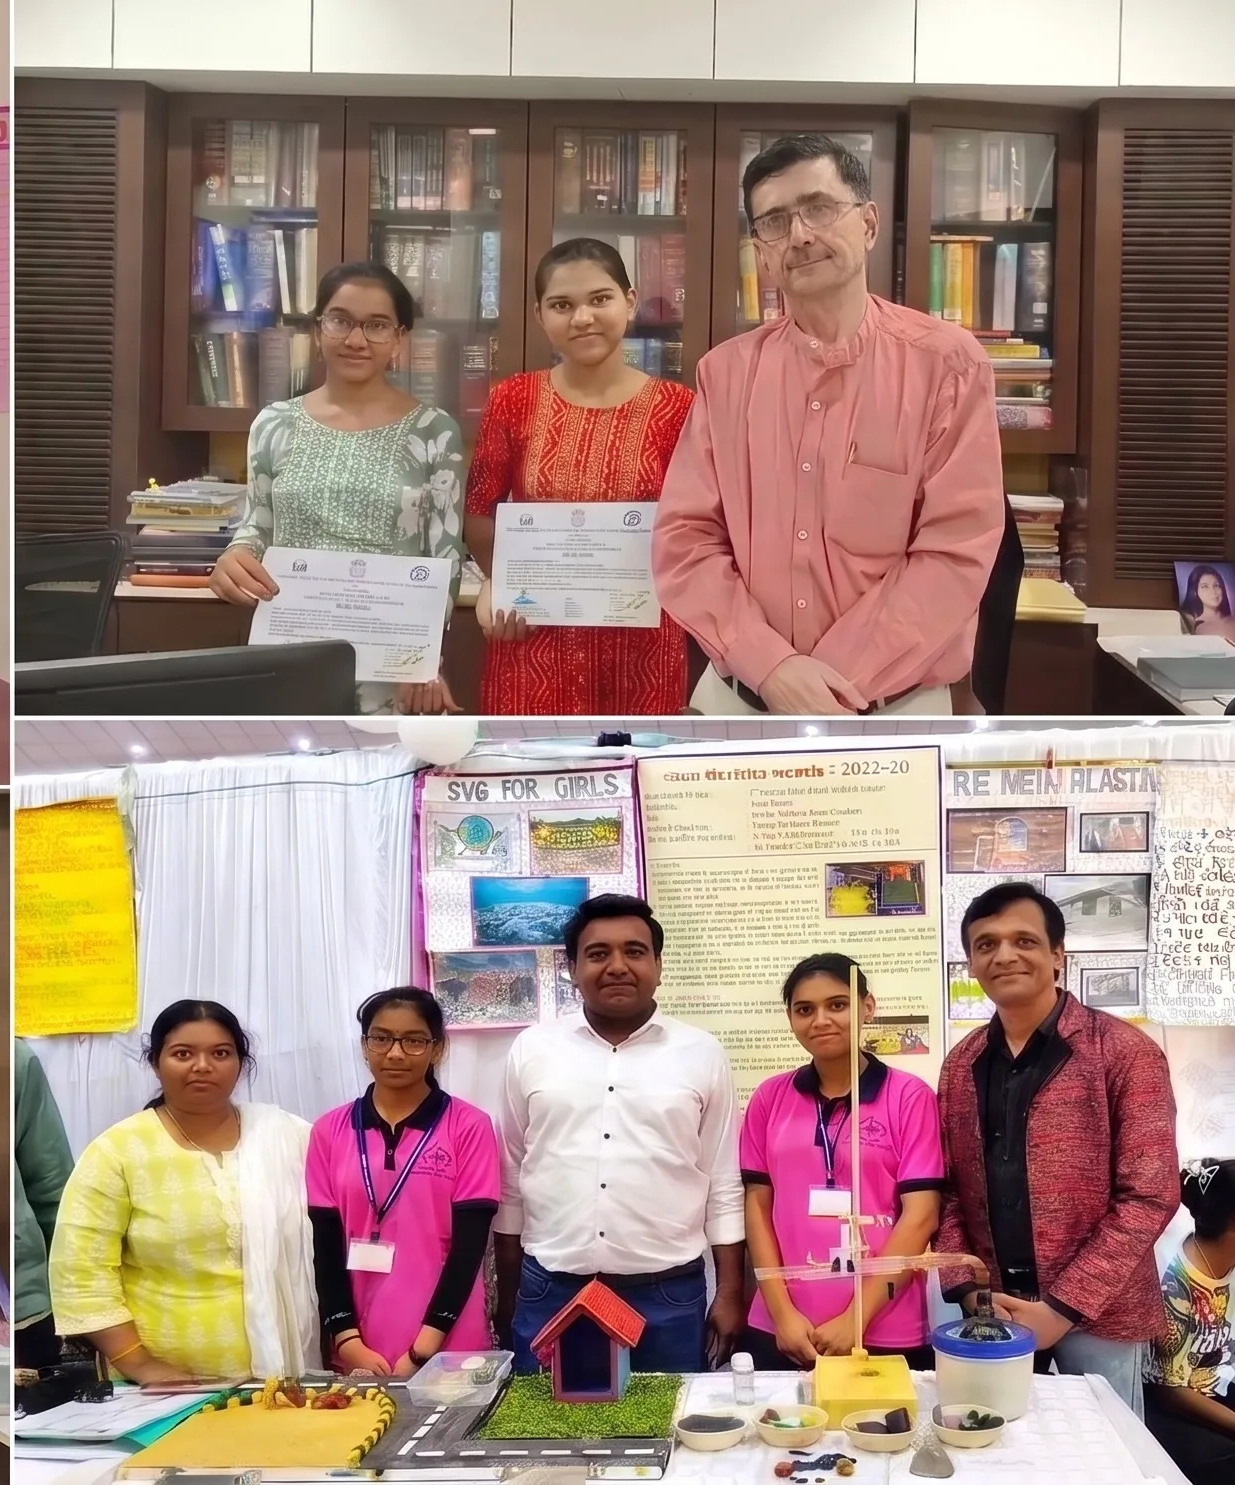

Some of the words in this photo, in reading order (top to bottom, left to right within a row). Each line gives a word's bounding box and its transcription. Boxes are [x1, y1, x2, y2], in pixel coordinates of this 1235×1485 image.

[840, 760, 910, 777] 2022-20
[447, 780, 489, 802] SVG
[501, 778, 540, 800] FOR
[554, 773, 619, 799] GIRLS
[953, 770, 991, 797] RE
